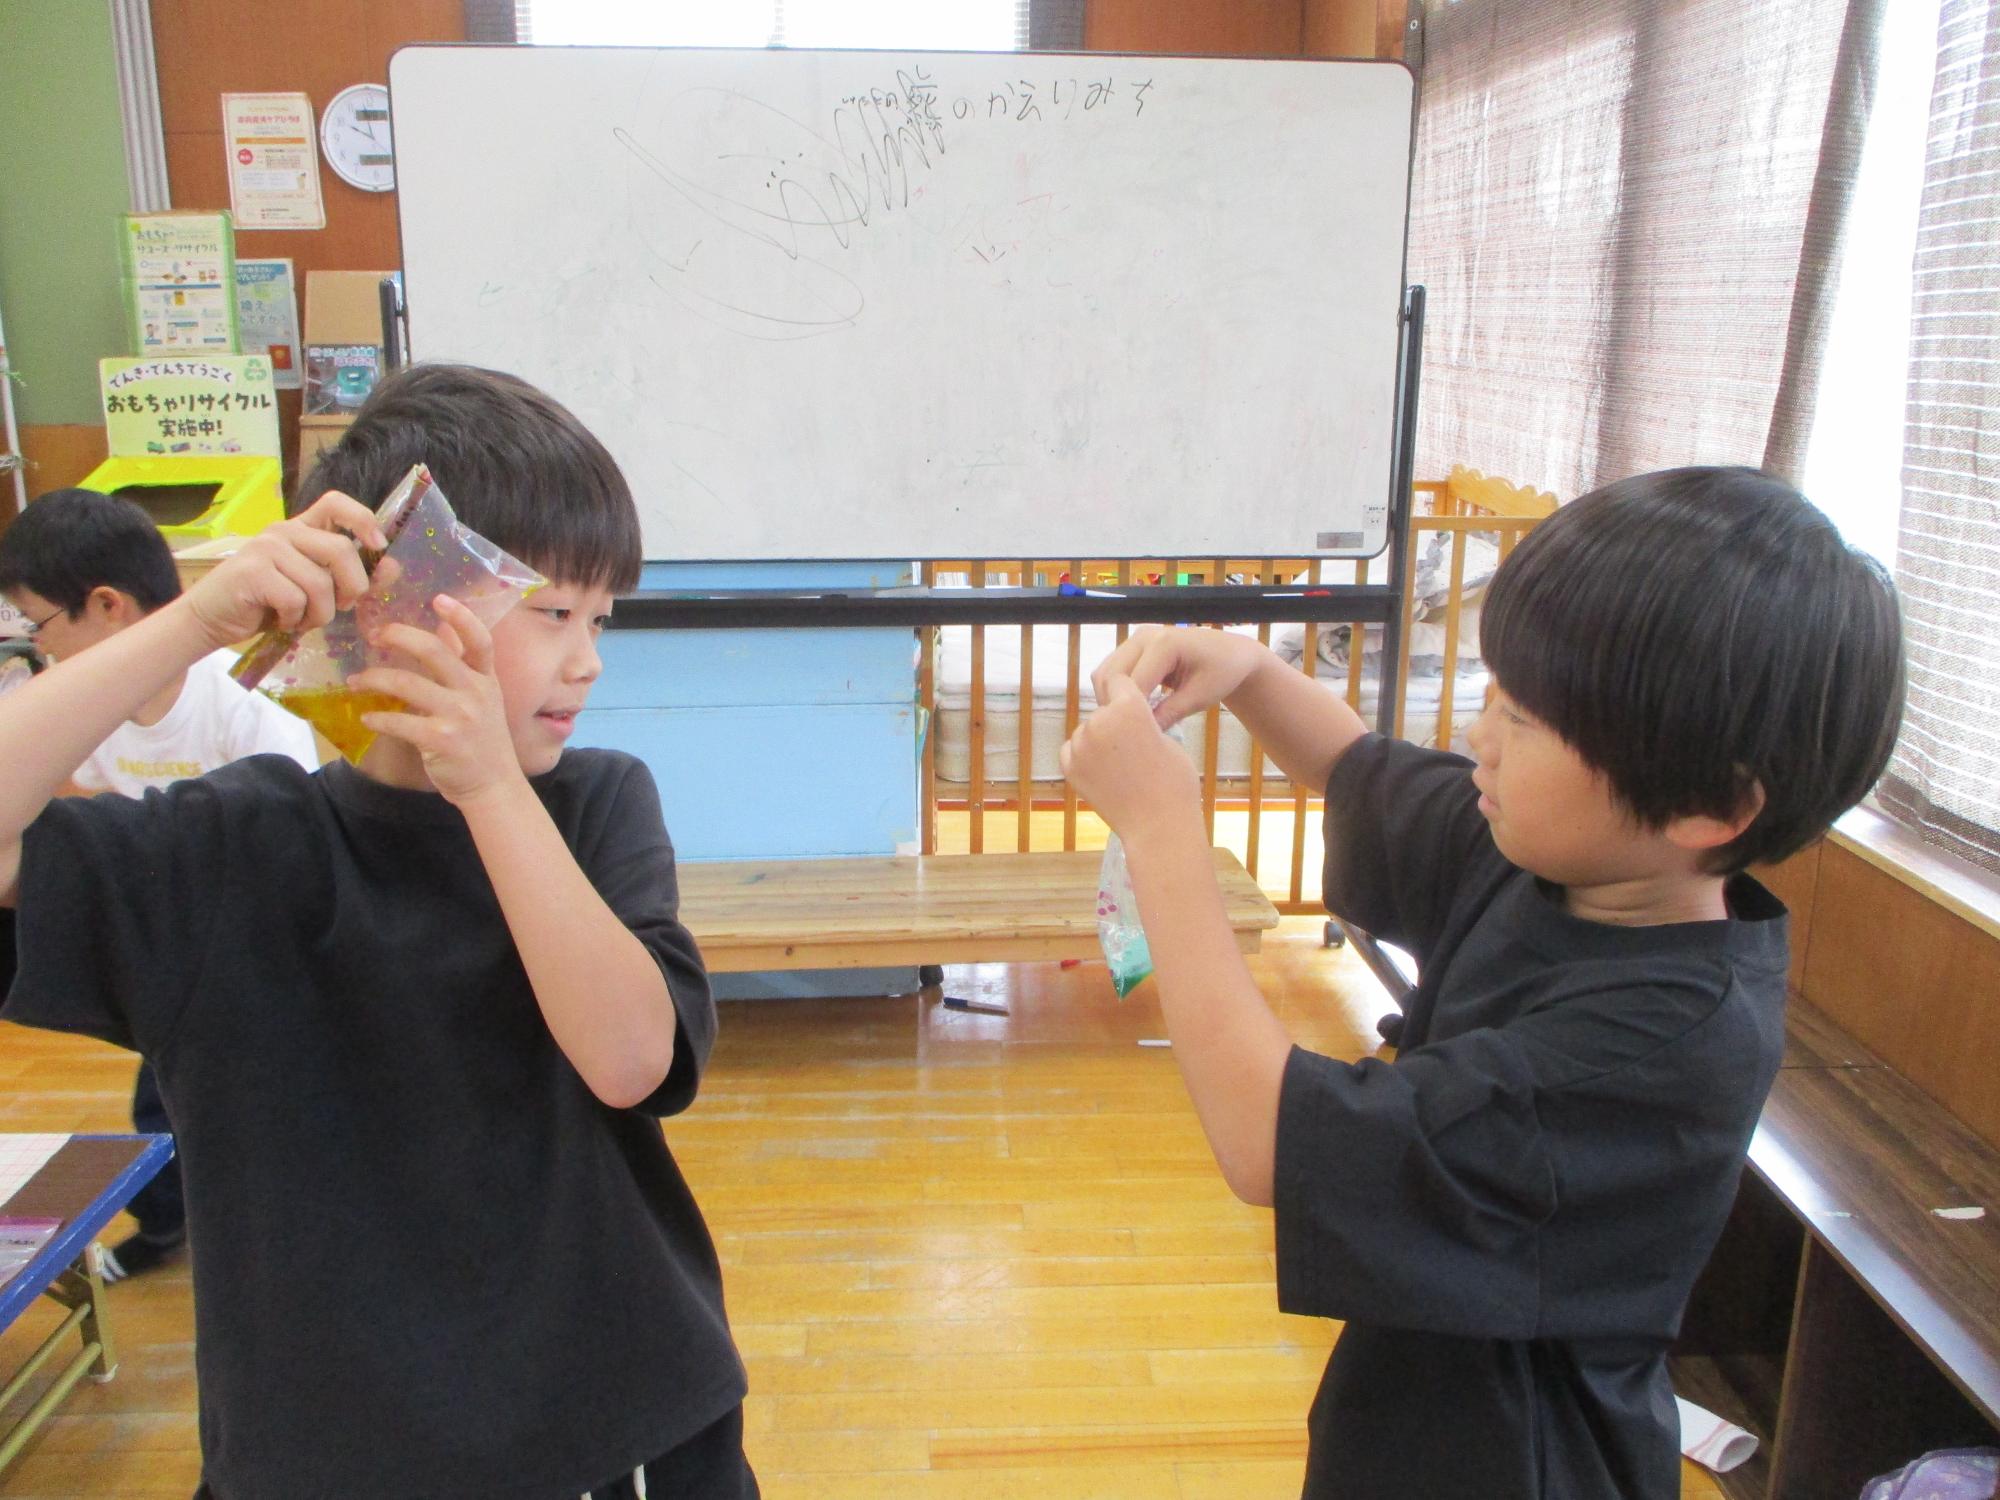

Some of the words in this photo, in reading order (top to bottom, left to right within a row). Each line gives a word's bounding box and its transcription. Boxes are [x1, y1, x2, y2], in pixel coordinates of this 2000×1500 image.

[107, 393, 271, 413] おもちゃリサイクル
